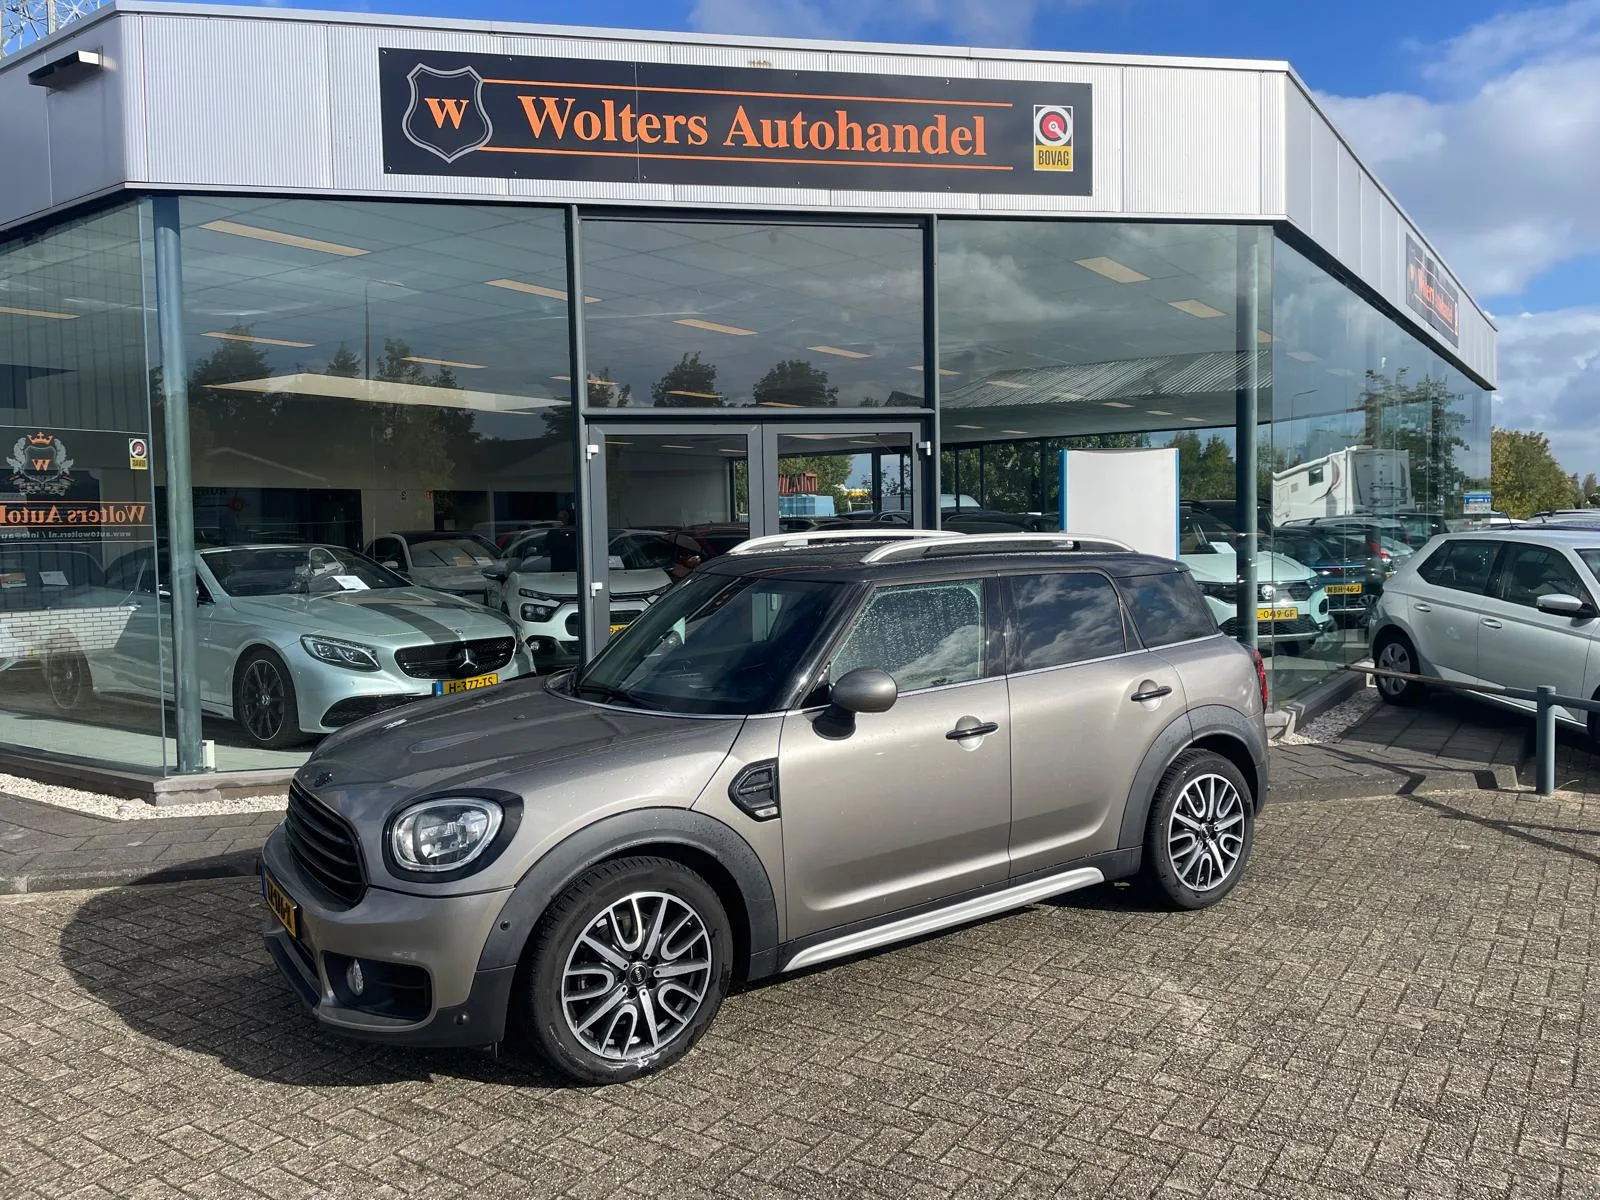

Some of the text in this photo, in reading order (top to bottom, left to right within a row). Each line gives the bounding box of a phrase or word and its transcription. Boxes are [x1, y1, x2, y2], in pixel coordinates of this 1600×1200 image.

[424, 97, 469, 129] W
[517, 95, 986, 156] Wolters Autohandel
[1038, 150, 1069, 165] BOVAG
[1257, 609, 1295, 618] -049-GF
[449, 676, 493, 693] H-377-TS
